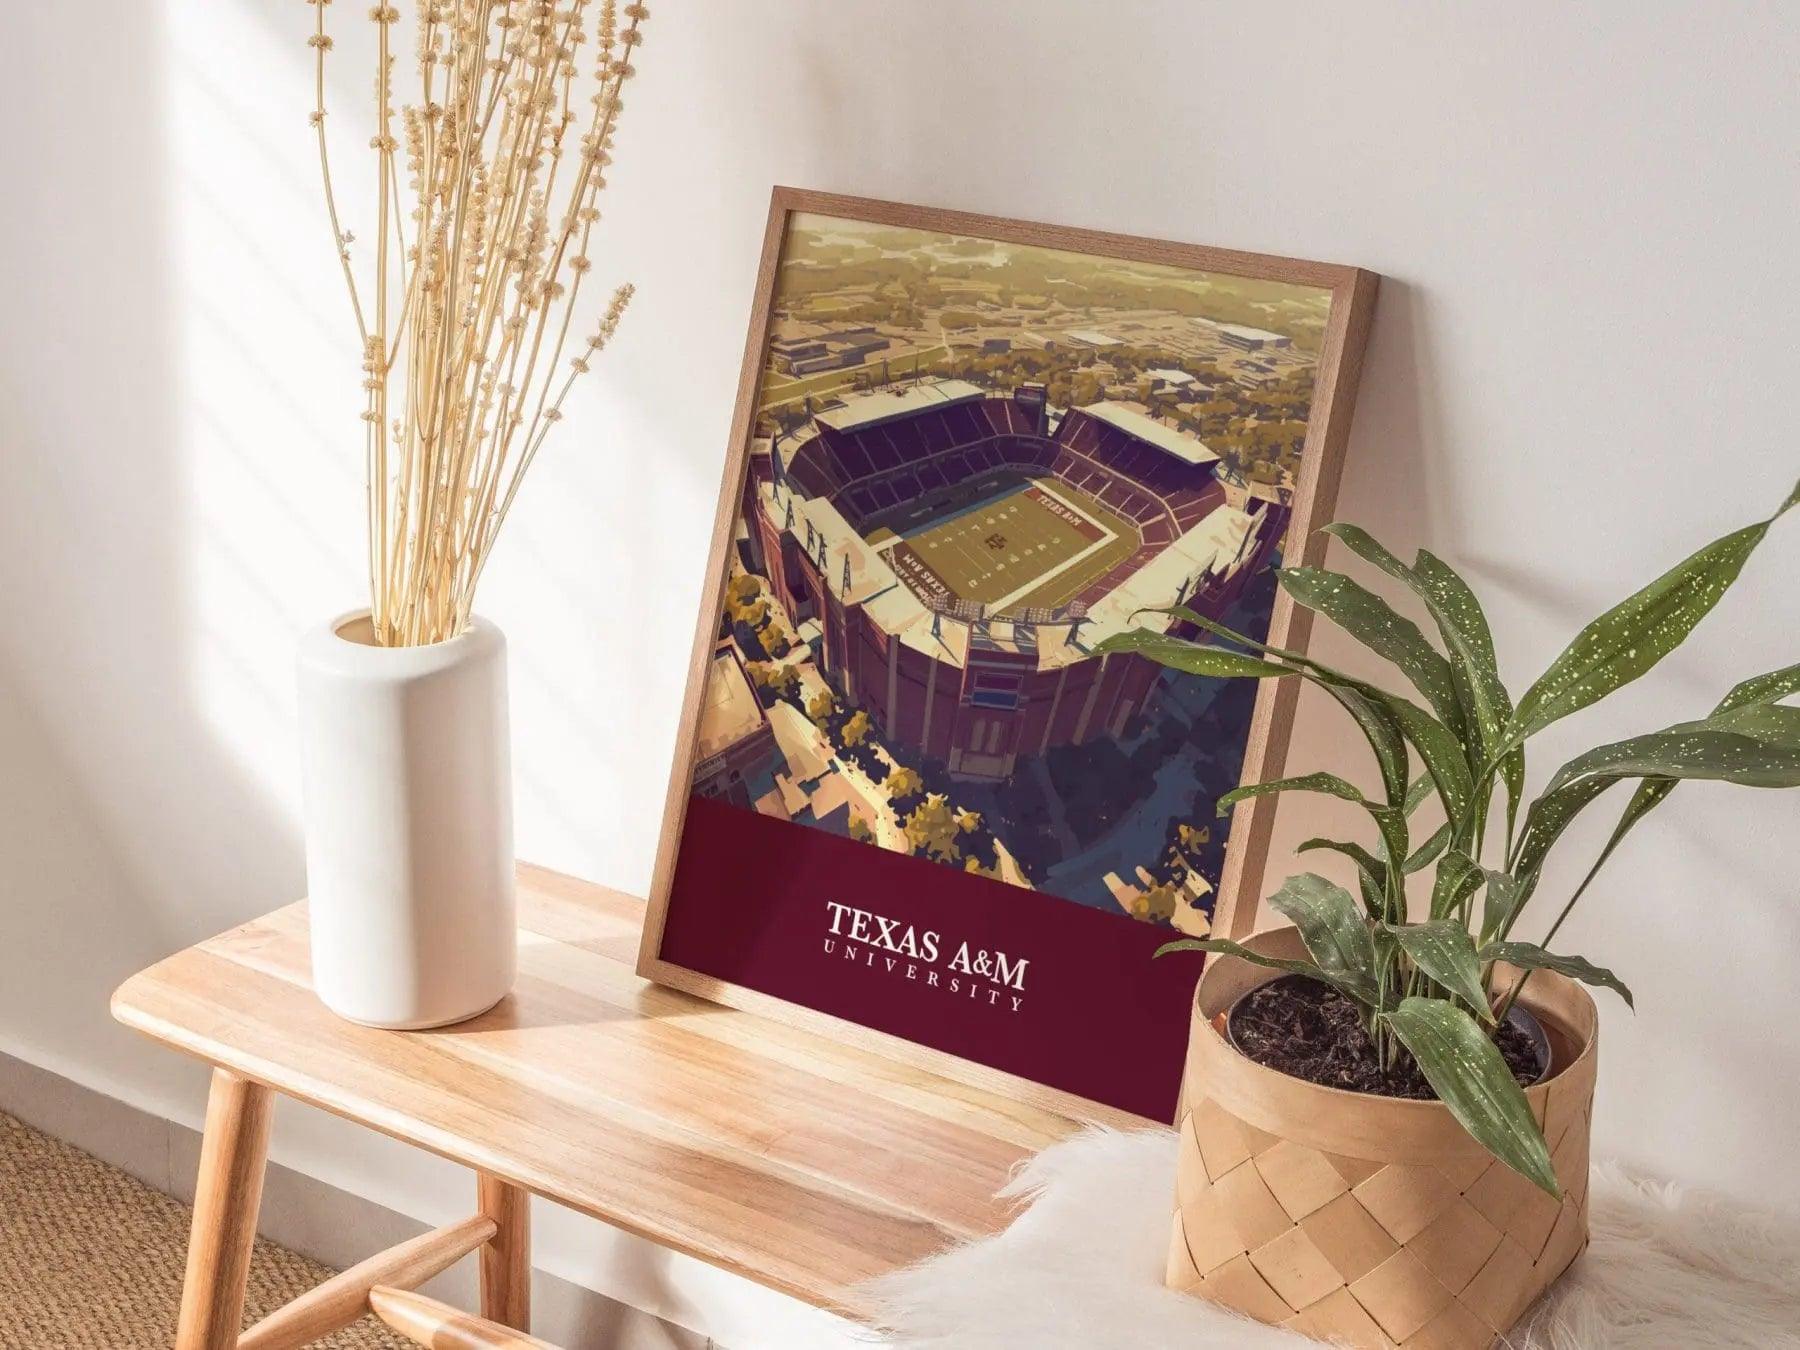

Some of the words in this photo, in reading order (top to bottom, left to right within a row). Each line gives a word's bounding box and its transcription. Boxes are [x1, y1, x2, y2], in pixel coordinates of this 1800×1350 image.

[823, 938, 1024, 1012] UNIVERSITY
[826, 900, 941, 963] TEXAS
[948, 941, 1030, 991] A&M
